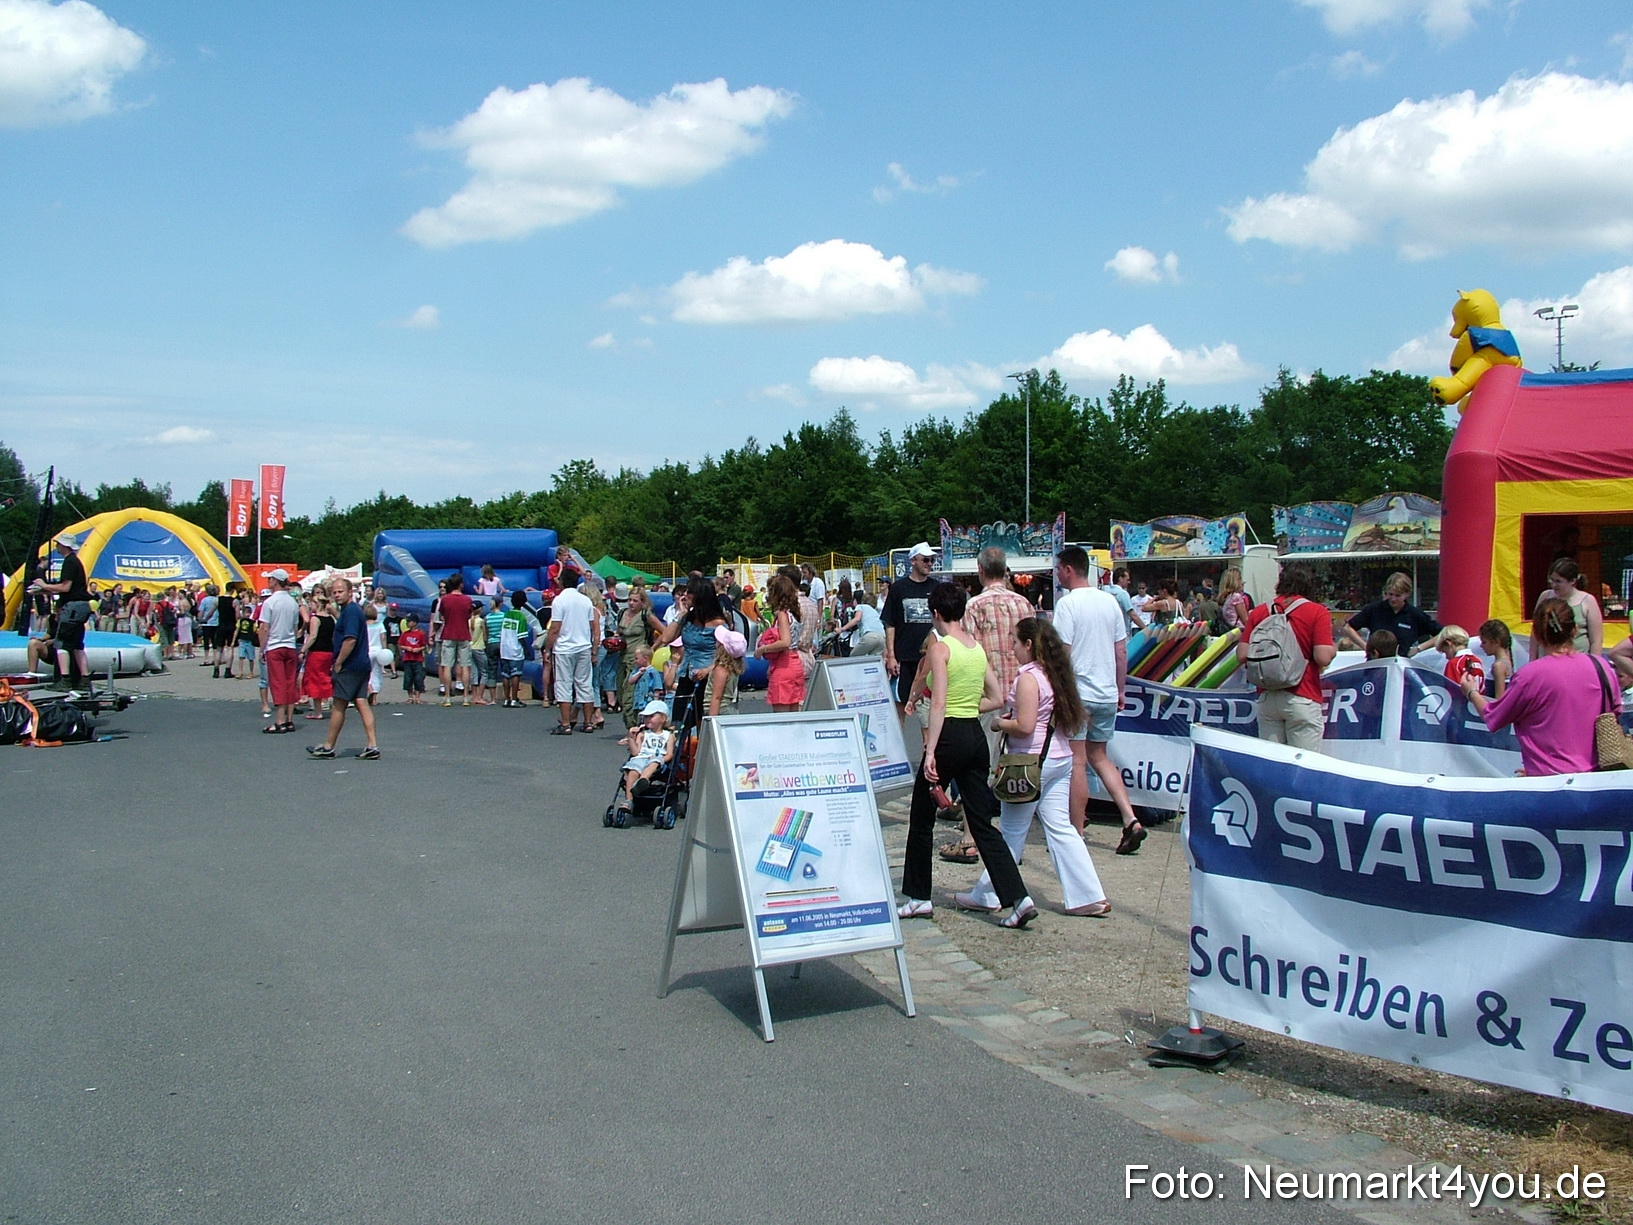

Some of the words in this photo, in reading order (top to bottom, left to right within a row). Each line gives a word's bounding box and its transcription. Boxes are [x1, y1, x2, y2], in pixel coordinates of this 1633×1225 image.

[761, 769, 856, 788] Malwettbewerb
[1007, 778, 1029, 793] 08
[1190, 925, 1448, 1038] Schreiben
[1475, 989, 1525, 1051] &
